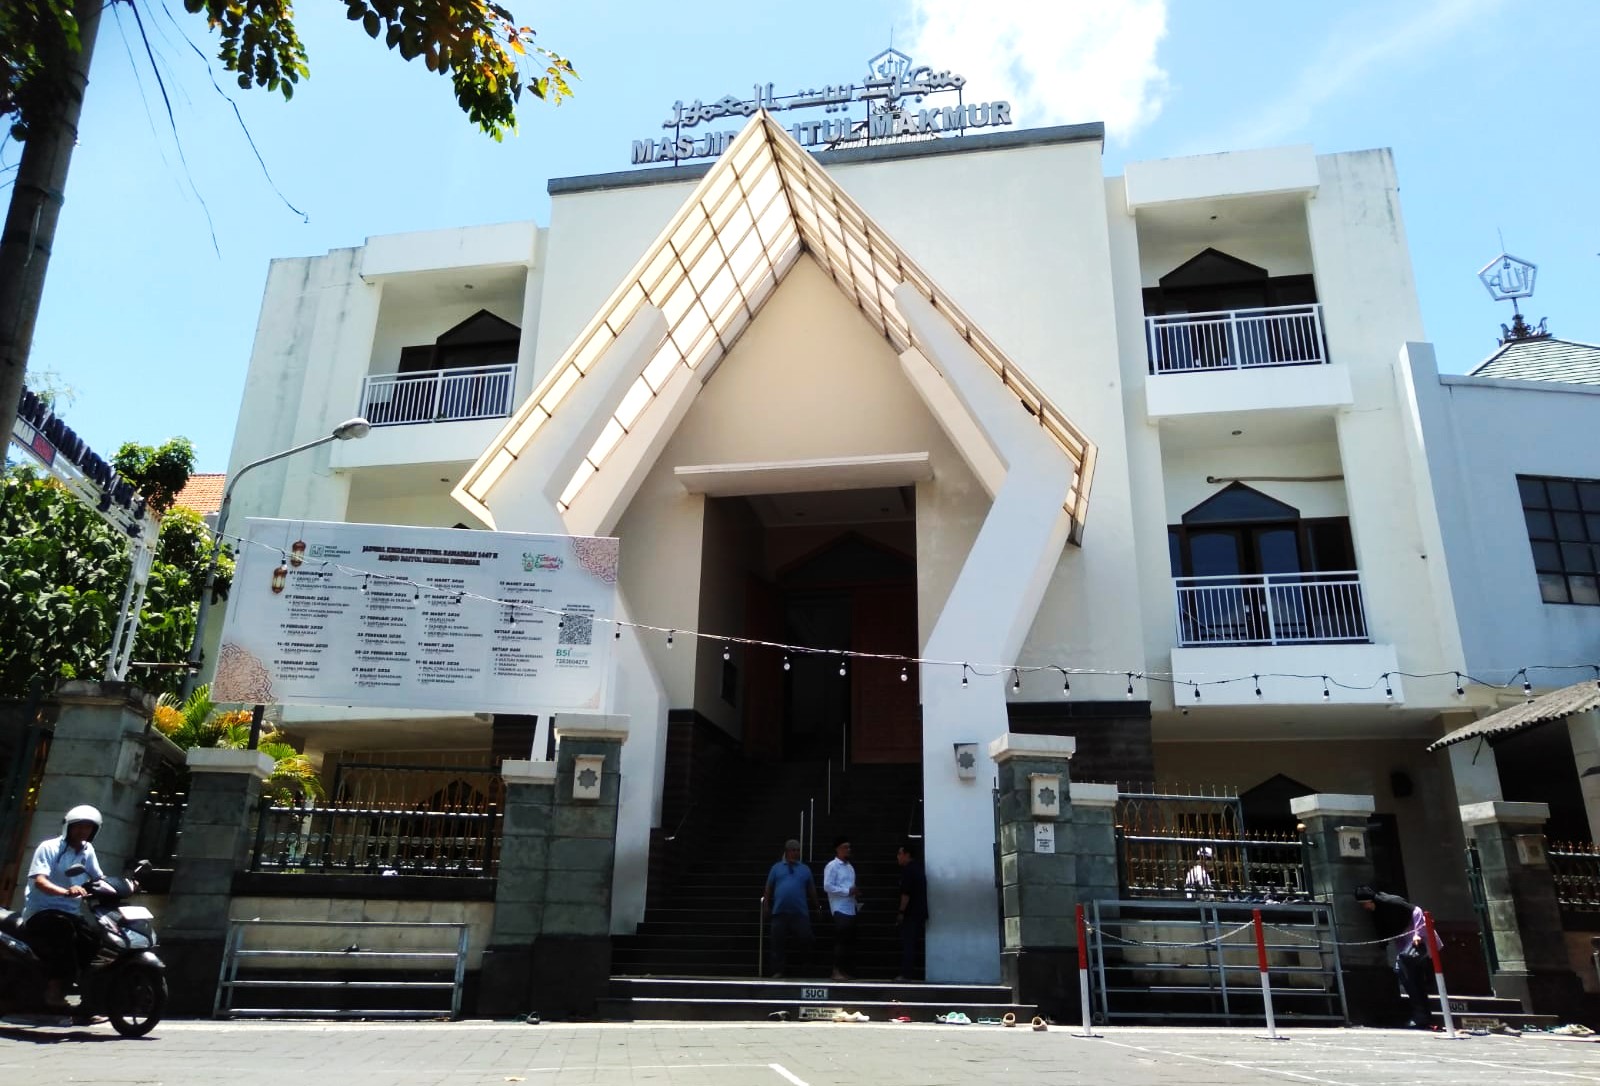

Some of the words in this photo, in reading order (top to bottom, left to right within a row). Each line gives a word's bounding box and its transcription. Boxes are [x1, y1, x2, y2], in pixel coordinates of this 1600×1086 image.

[791, 117, 861, 147] ITUL
[869, 100, 1013, 141] MAKMUR
[556, 648, 571, 657] BSI
[805, 989, 825, 998] SUCI
